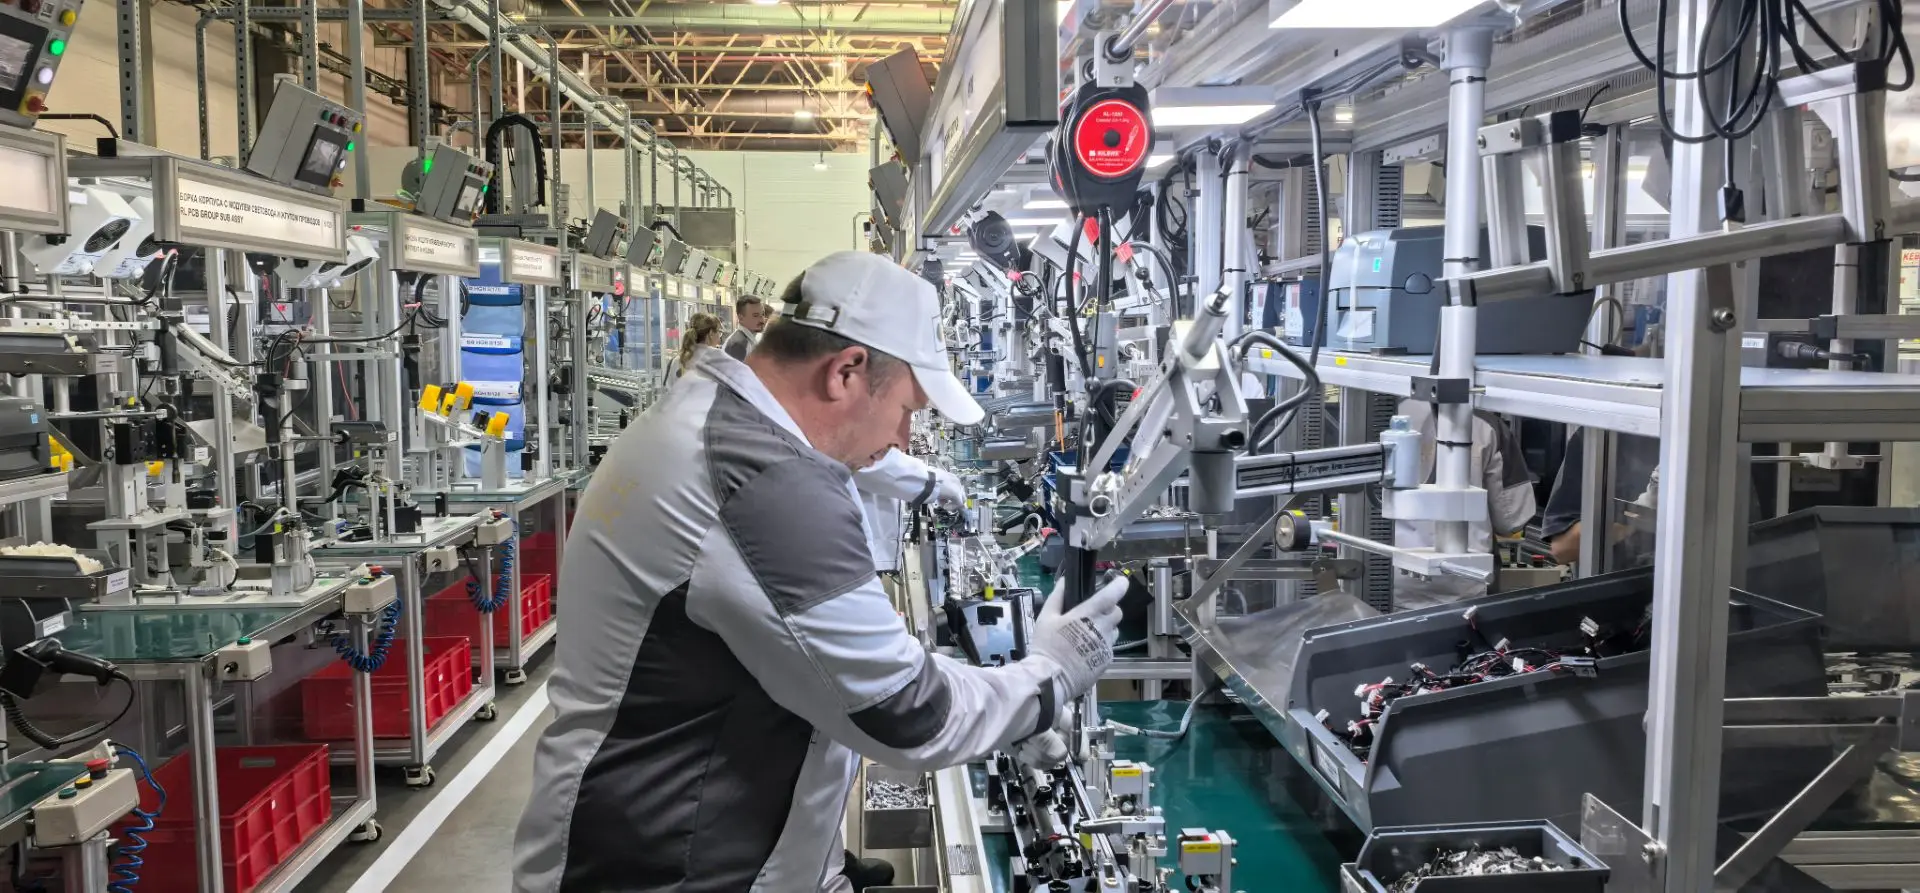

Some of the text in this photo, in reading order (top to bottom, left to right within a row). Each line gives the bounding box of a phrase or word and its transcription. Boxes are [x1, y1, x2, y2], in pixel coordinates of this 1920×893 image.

[179, 192, 198, 203] БОРКА
[188, 207, 200, 218] PCB
[200, 209, 219, 220] GROUP
[219, 212, 231, 222] SUB
[231, 214, 244, 224] ASSY
